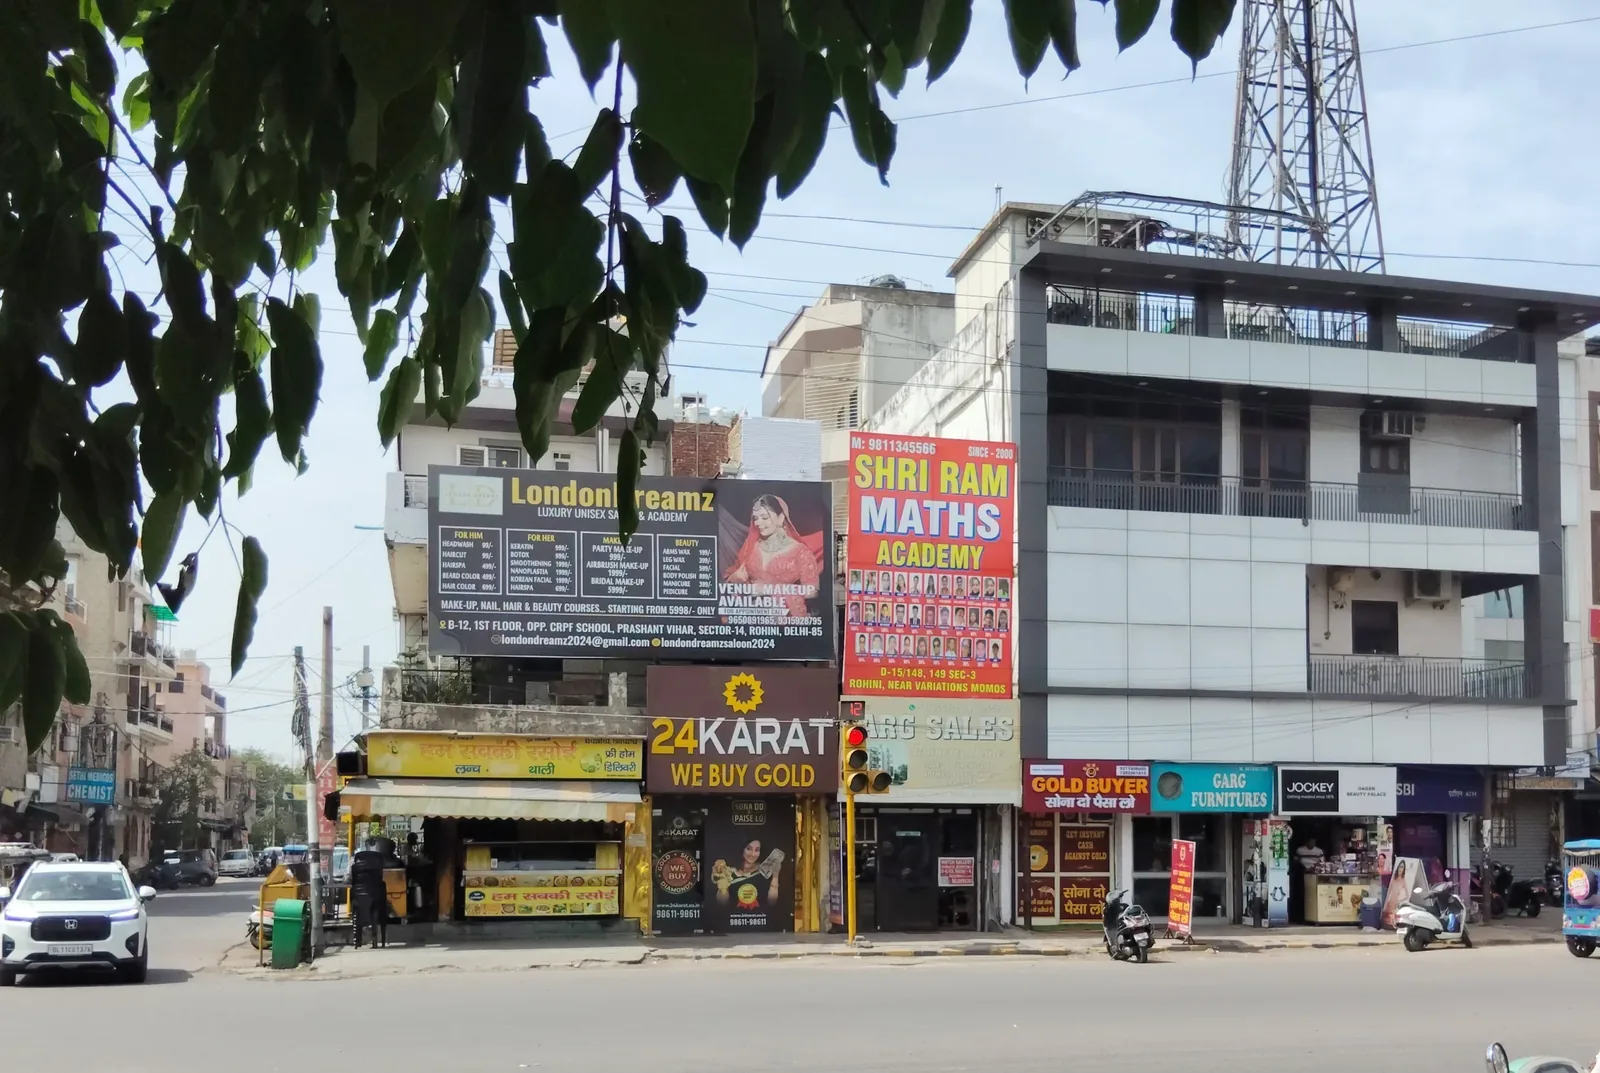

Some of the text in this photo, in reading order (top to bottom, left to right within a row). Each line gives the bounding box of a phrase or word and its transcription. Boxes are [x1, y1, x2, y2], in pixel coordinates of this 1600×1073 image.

[869, 438, 936, 455] 9811345566
[968, 446, 1013, 459] SINCE 2000
[855, 454, 1010, 497] SHRI RAM
[512, 477, 714, 511] Londonreamz
[538, 507, 572, 518] LUXURY
[575, 509, 605, 520] UNISEX
[648, 512, 688, 522] ACADEMY
[860, 495, 1001, 541] MATHS
[469, 532, 484, 540] HIM
[528, 534, 541, 542] FOR
[442, 540, 474, 548] HEADWASH
[876, 540, 984, 571] ACADEMY
[619, 562, 649, 570] MAKE-UP
[461, 572, 480, 580] COLOR
[534, 576, 552, 584] FACIAL
[614, 578, 645, 586] MAKE-UP
[663, 580, 690, 588] MANICURE
[718, 583, 816, 596] VENUE MAKEUP
[441, 600, 480, 612] MAKE-UP,
[480, 601, 500, 612] NAIL,
[503, 602, 522, 611] HAIR
[525, 602, 531, 611] &
[532, 602, 562, 612] BEAUTY
[608, 604, 644, 614] STARTING
[646, 605, 668, 614] FROM
[669, 606, 696, 616] 5998/-
[697, 606, 716, 616] ONLY
[718, 596, 786, 608] AVAILABLE
[778, 616, 822, 626] 9315928795
[448, 620, 822, 638] B-12, 1ST FLOOR, OPP. CRPF SCHOOL, PRASHANT VIHAR, SECTOR-14, ROHINI, DELHI-85
[501, 634, 776, 649] londondreamz2024@gmail.com londondreamzsaloon2024
[880, 667, 976, 680] D-15/148, 149 SEC-3
[850, 678, 1006, 694] ROHINI, NEAR VARIATIONS MOMOS
[850, 702, 863, 716] 12
[926, 715, 1014, 741] SALES
[651, 716, 834, 756] 24KARAT
[619, 748, 636, 759] होम
[528, 762, 555, 775] थाली
[670, 763, 816, 788] WE BUY GOLD
[1212, 773, 1246, 788] GARG
[68, 784, 113, 800] CHEMIST
[1032, 777, 1148, 794] GOLD BUYER
[1286, 782, 1334, 792] JOCKEY
[1396, 783, 1415, 796] SBI
[1044, 794, 1136, 809] सोना दो पैसा लो
[1191, 792, 1267, 808] FURNITURES
[734, 814, 754, 822] PAISE
[1066, 830, 1078, 838] GET
[1078, 842, 1094, 850] CASH
[680, 852, 697, 872] SILVER
[1064, 852, 1107, 860] AGAINST GOLD
[658, 854, 671, 872] GOLD
[670, 864, 684, 872] WE
[668, 872, 686, 880] BUY
[492, 892, 517, 901] हम
[523, 890, 570, 901] सबकी
[576, 890, 617, 900] रसोई
[1063, 884, 1106, 898] सोना दो
[656, 909, 700, 918] 98611-98611
[1064, 900, 1086, 914] पैसा
[730, 918, 766, 926] 98611-98611
